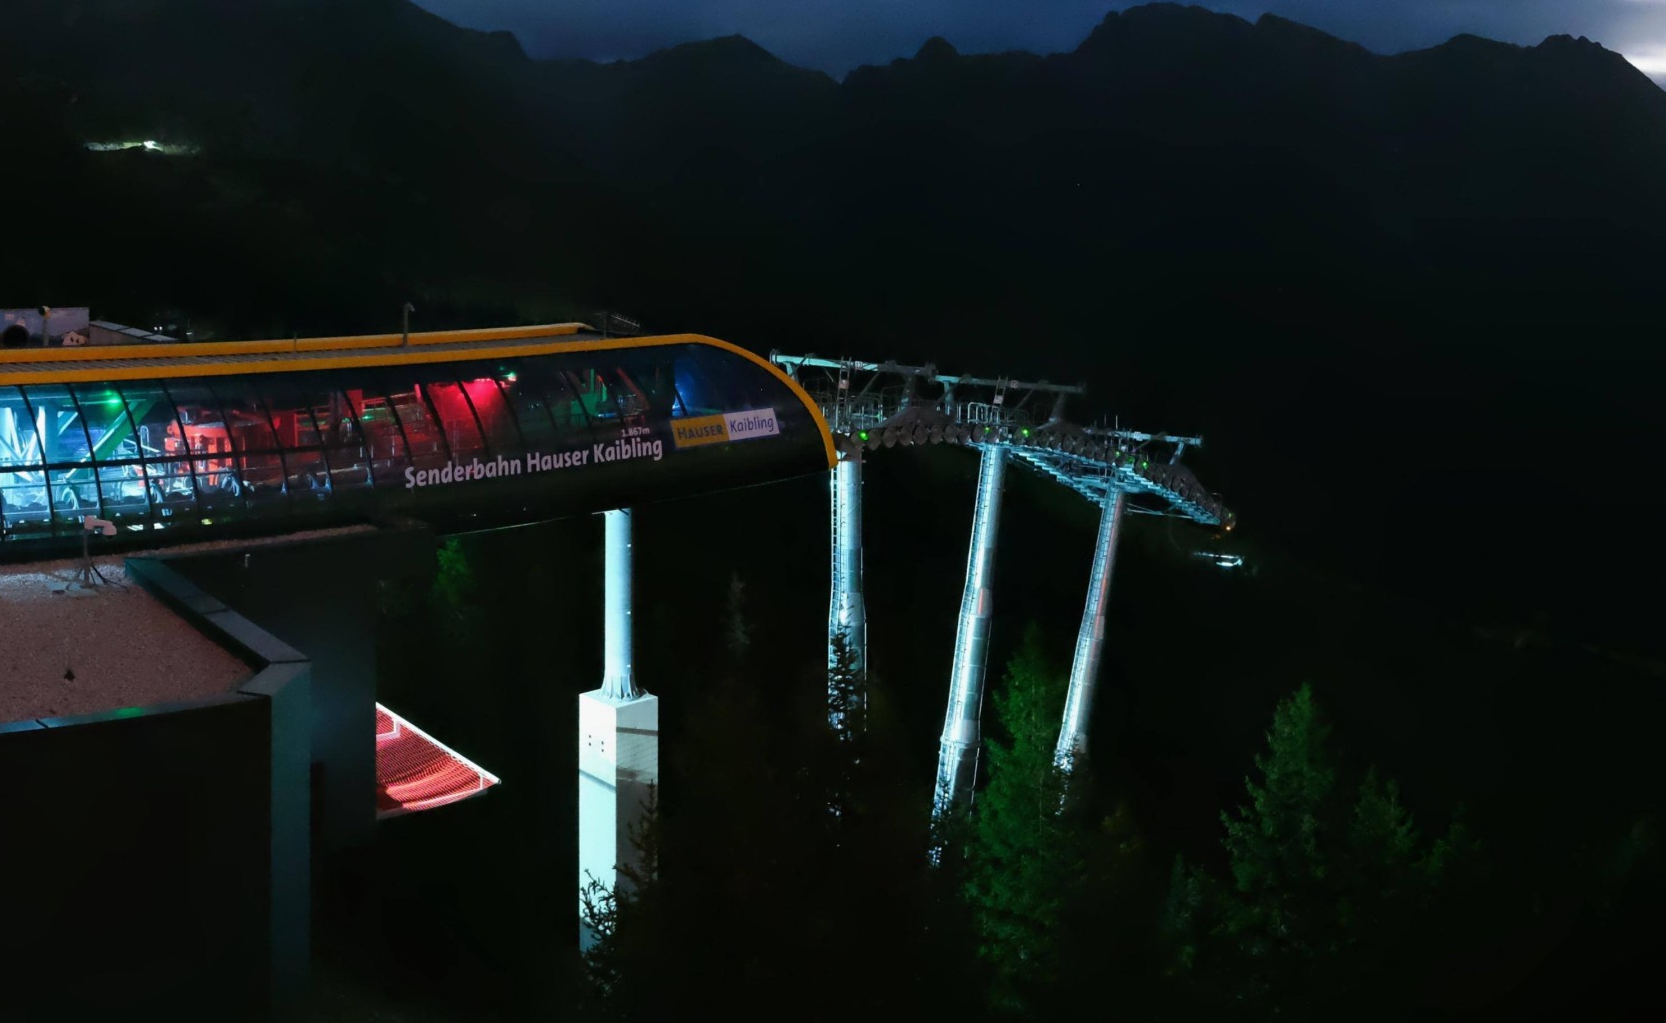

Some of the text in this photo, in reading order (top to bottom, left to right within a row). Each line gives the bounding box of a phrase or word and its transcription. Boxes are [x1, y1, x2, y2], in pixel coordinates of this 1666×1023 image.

[677, 417, 774, 440] HAUSER Kaibling
[404, 437, 663, 489] Senderbahn Hauser Kaibling
